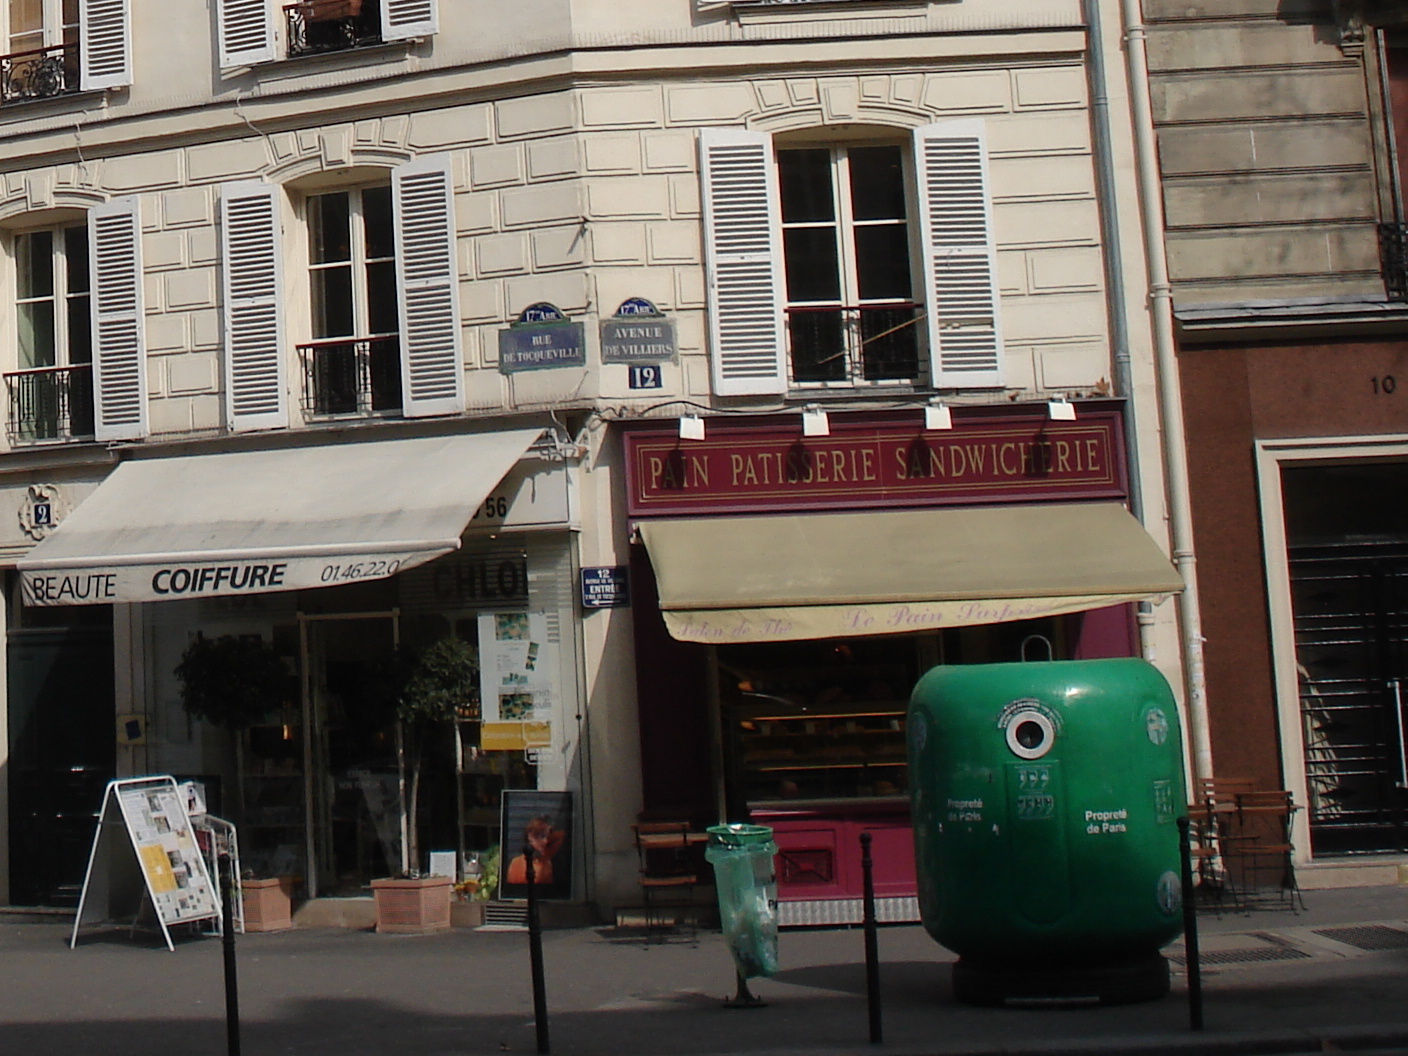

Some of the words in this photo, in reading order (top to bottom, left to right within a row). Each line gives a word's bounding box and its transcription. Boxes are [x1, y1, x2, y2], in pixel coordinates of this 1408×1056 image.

[532, 334, 552, 346] RUE
[614, 327, 662, 339] AVENUE
[503, 352, 516, 363] DE
[517, 347, 581, 362] TOCQUEVILLE
[605, 345, 621, 356] DE
[622, 341, 673, 356] VILLIERS
[634, 367, 656, 388] 12
[1371, 375, 1396, 394] 10
[650, 455, 709, 489] PAIN
[730, 449, 876, 486] PATISSERIE
[895, 440, 1100, 480] SANDWICHERIE
[38, 505, 48, 523] 2
[485, 496, 507, 518] 56
[33, 574, 117, 601] BEAUTE
[152, 563, 287, 595] COIFFURE
[597, 569, 610, 578] 12
[886, 605, 942, 626] Pain
[1085, 809, 1127, 822] Propreté
[1087, 823, 1100, 834] de
[1102, 822, 1126, 833] Paris
